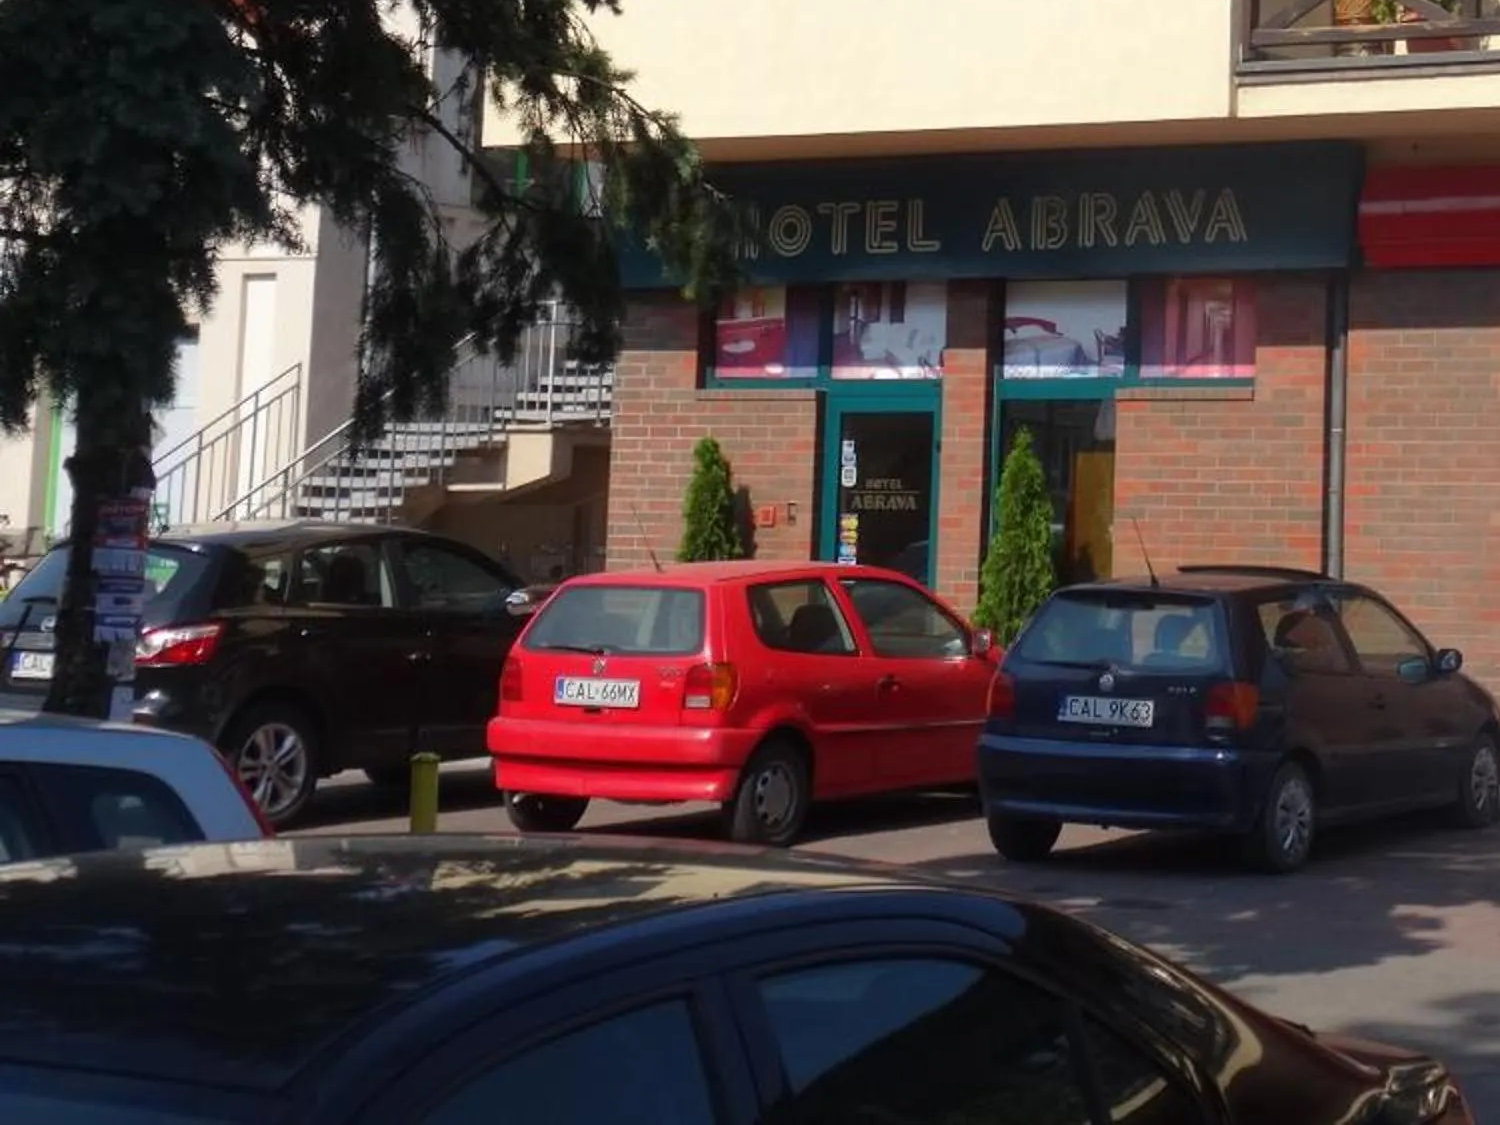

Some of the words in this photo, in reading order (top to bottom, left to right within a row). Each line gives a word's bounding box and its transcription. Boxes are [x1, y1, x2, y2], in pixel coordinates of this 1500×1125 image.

[981, 187, 1248, 252] ABRAVA
[851, 495, 917, 510] ABRAVA
[566, 681, 596, 700] CAL
[1069, 698, 1101, 718] CAL
[1109, 702, 1151, 721] 9K63
